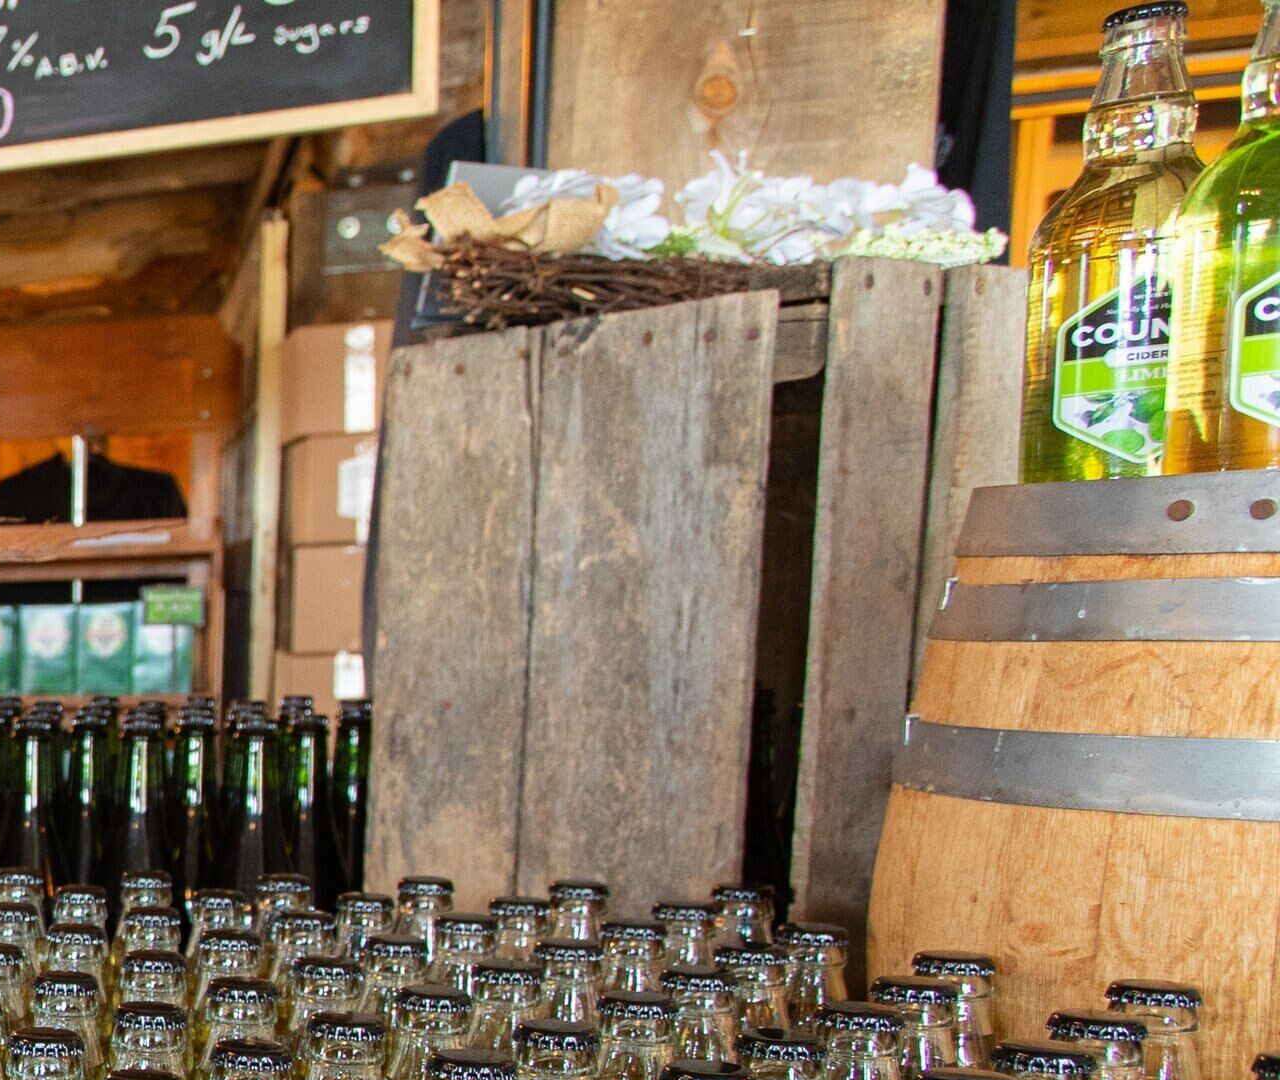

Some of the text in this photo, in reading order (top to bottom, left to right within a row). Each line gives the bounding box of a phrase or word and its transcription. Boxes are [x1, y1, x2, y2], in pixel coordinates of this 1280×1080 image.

[143, 1, 197, 59] 5
[273, 15, 371, 54] sugars
[1071, 316, 1170, 347] COUN
